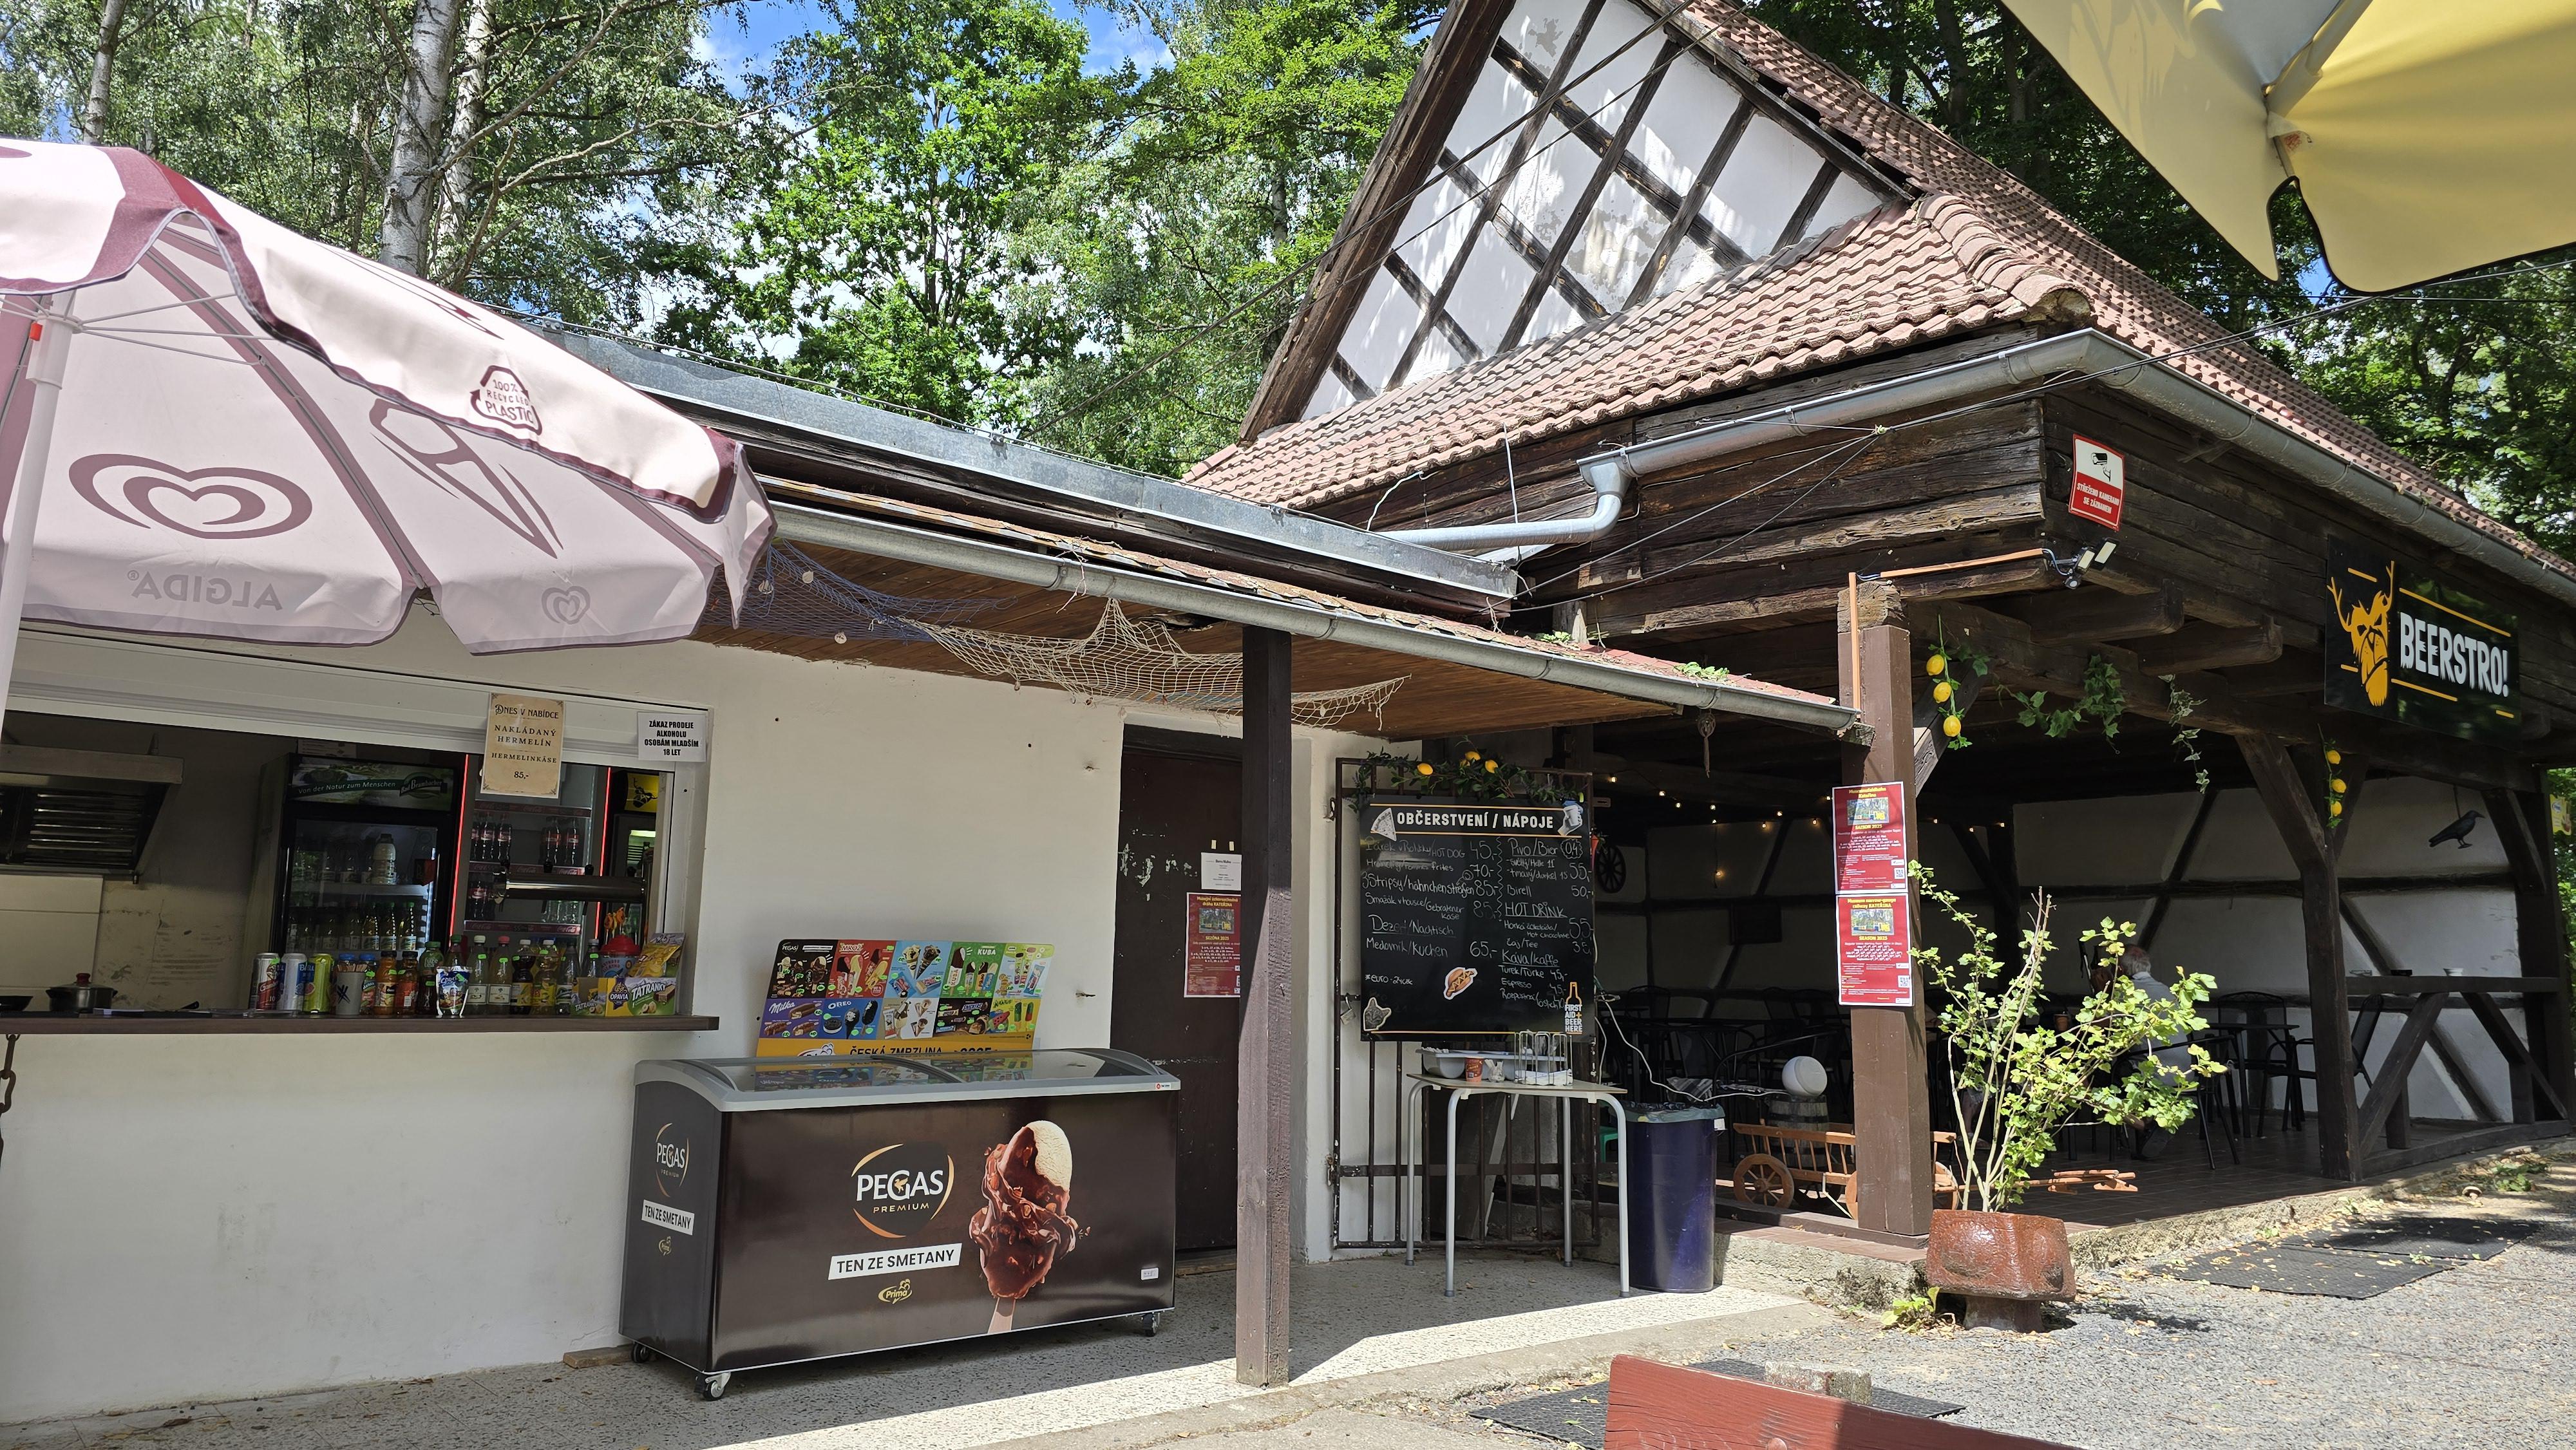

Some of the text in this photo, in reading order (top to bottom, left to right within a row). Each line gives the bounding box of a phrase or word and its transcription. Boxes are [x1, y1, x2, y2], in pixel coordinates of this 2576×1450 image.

[493, 379, 518, 392] 100%
[487, 390, 529, 406] RECYCLED
[485, 400, 534, 424] PLASTIC
[2400, 612, 2509, 697] BEERSTRO!
[495, 725, 556, 736] NAKLÁDANÝ
[498, 736, 551, 746] HERMELÍN
[1397, 810, 1489, 827] OBČERSTVENÍ
[1503, 813, 1553, 829] NÁPOJE
[1507, 884, 1532, 898] Birell
[1505, 901, 1529, 917] HOT
[632, 982, 666, 1001] TATRANKY
[769, 1001, 795, 1014] Milka
[828, 1001, 851, 1010] OREO
[656, 1142, 685, 1169] PEGAS
[857, 1170, 943, 1201] PEGAS
[873, 1203, 929, 1214] PREMIUM
[645, 1205, 692, 1229] TEN ZE SMETANY
[837, 1249, 954, 1274] TEN ZE SMETANY
[886, 1288, 907, 1299] Prima
